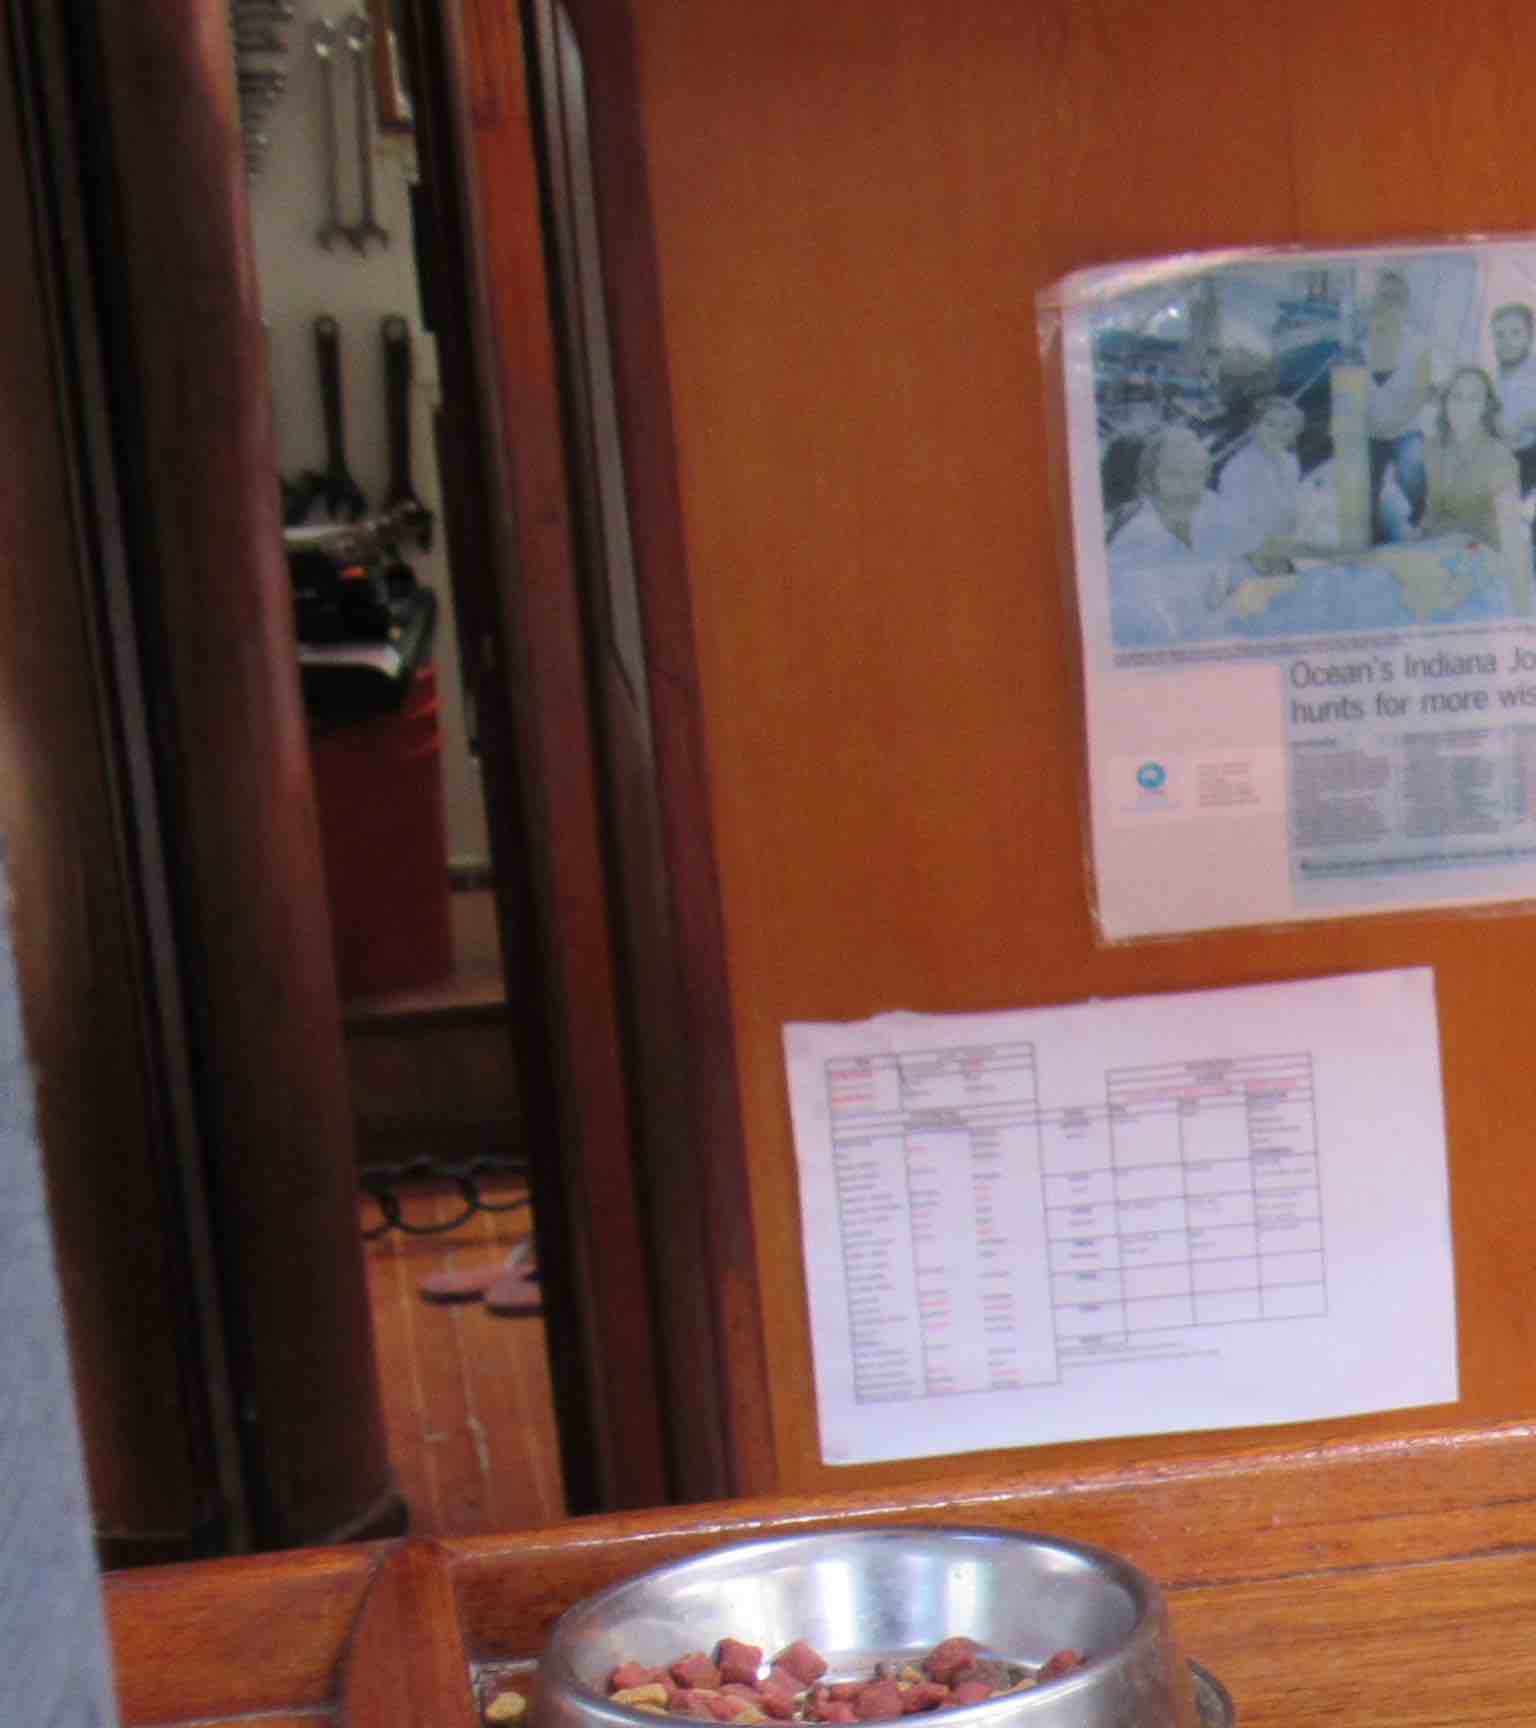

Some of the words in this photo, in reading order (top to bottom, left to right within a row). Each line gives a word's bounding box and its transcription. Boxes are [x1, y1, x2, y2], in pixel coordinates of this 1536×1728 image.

[1289, 656, 1394, 689] Ocean's
[1404, 650, 1498, 679] Indiana
[1290, 697, 1366, 725] hunts
[1375, 691, 1408, 718] for
[1421, 689, 1490, 714] more
